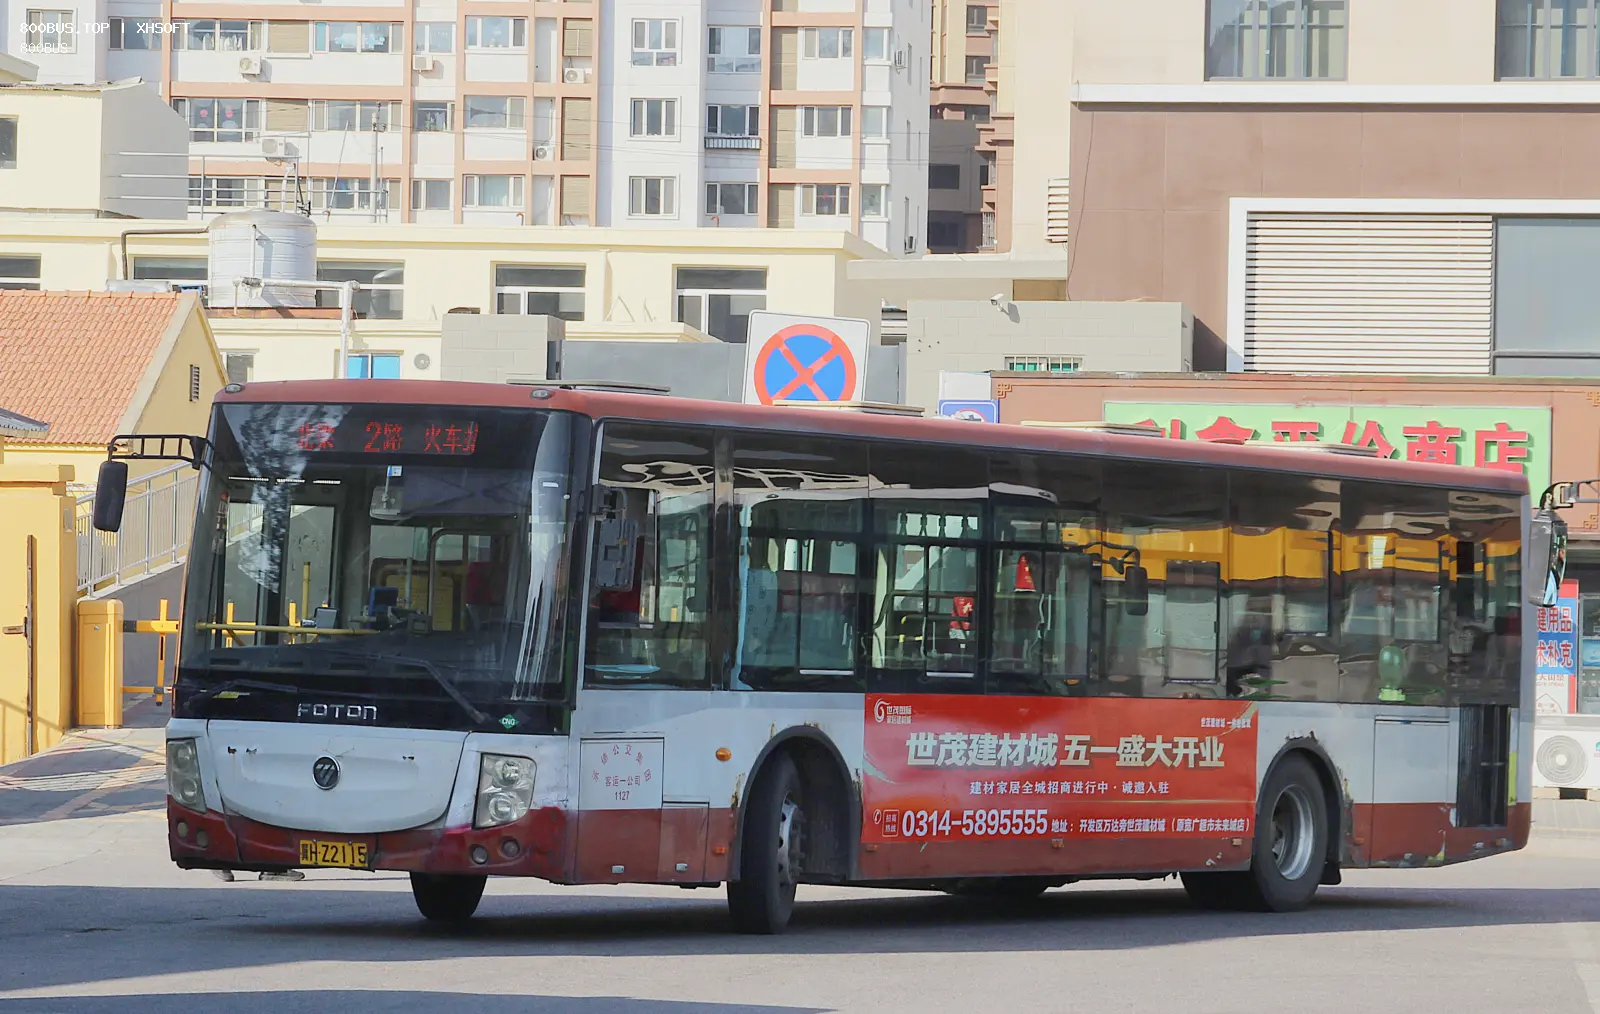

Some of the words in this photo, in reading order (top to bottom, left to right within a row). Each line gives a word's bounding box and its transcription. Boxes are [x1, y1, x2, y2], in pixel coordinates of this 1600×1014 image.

[297, 703, 377, 721] FOTON
[501, 716, 517, 727] CNG
[605, 775, 641, 787] 客运一公司
[615, 790, 630, 801] 1127
[902, 809, 1048, 837] 0314-5895555
